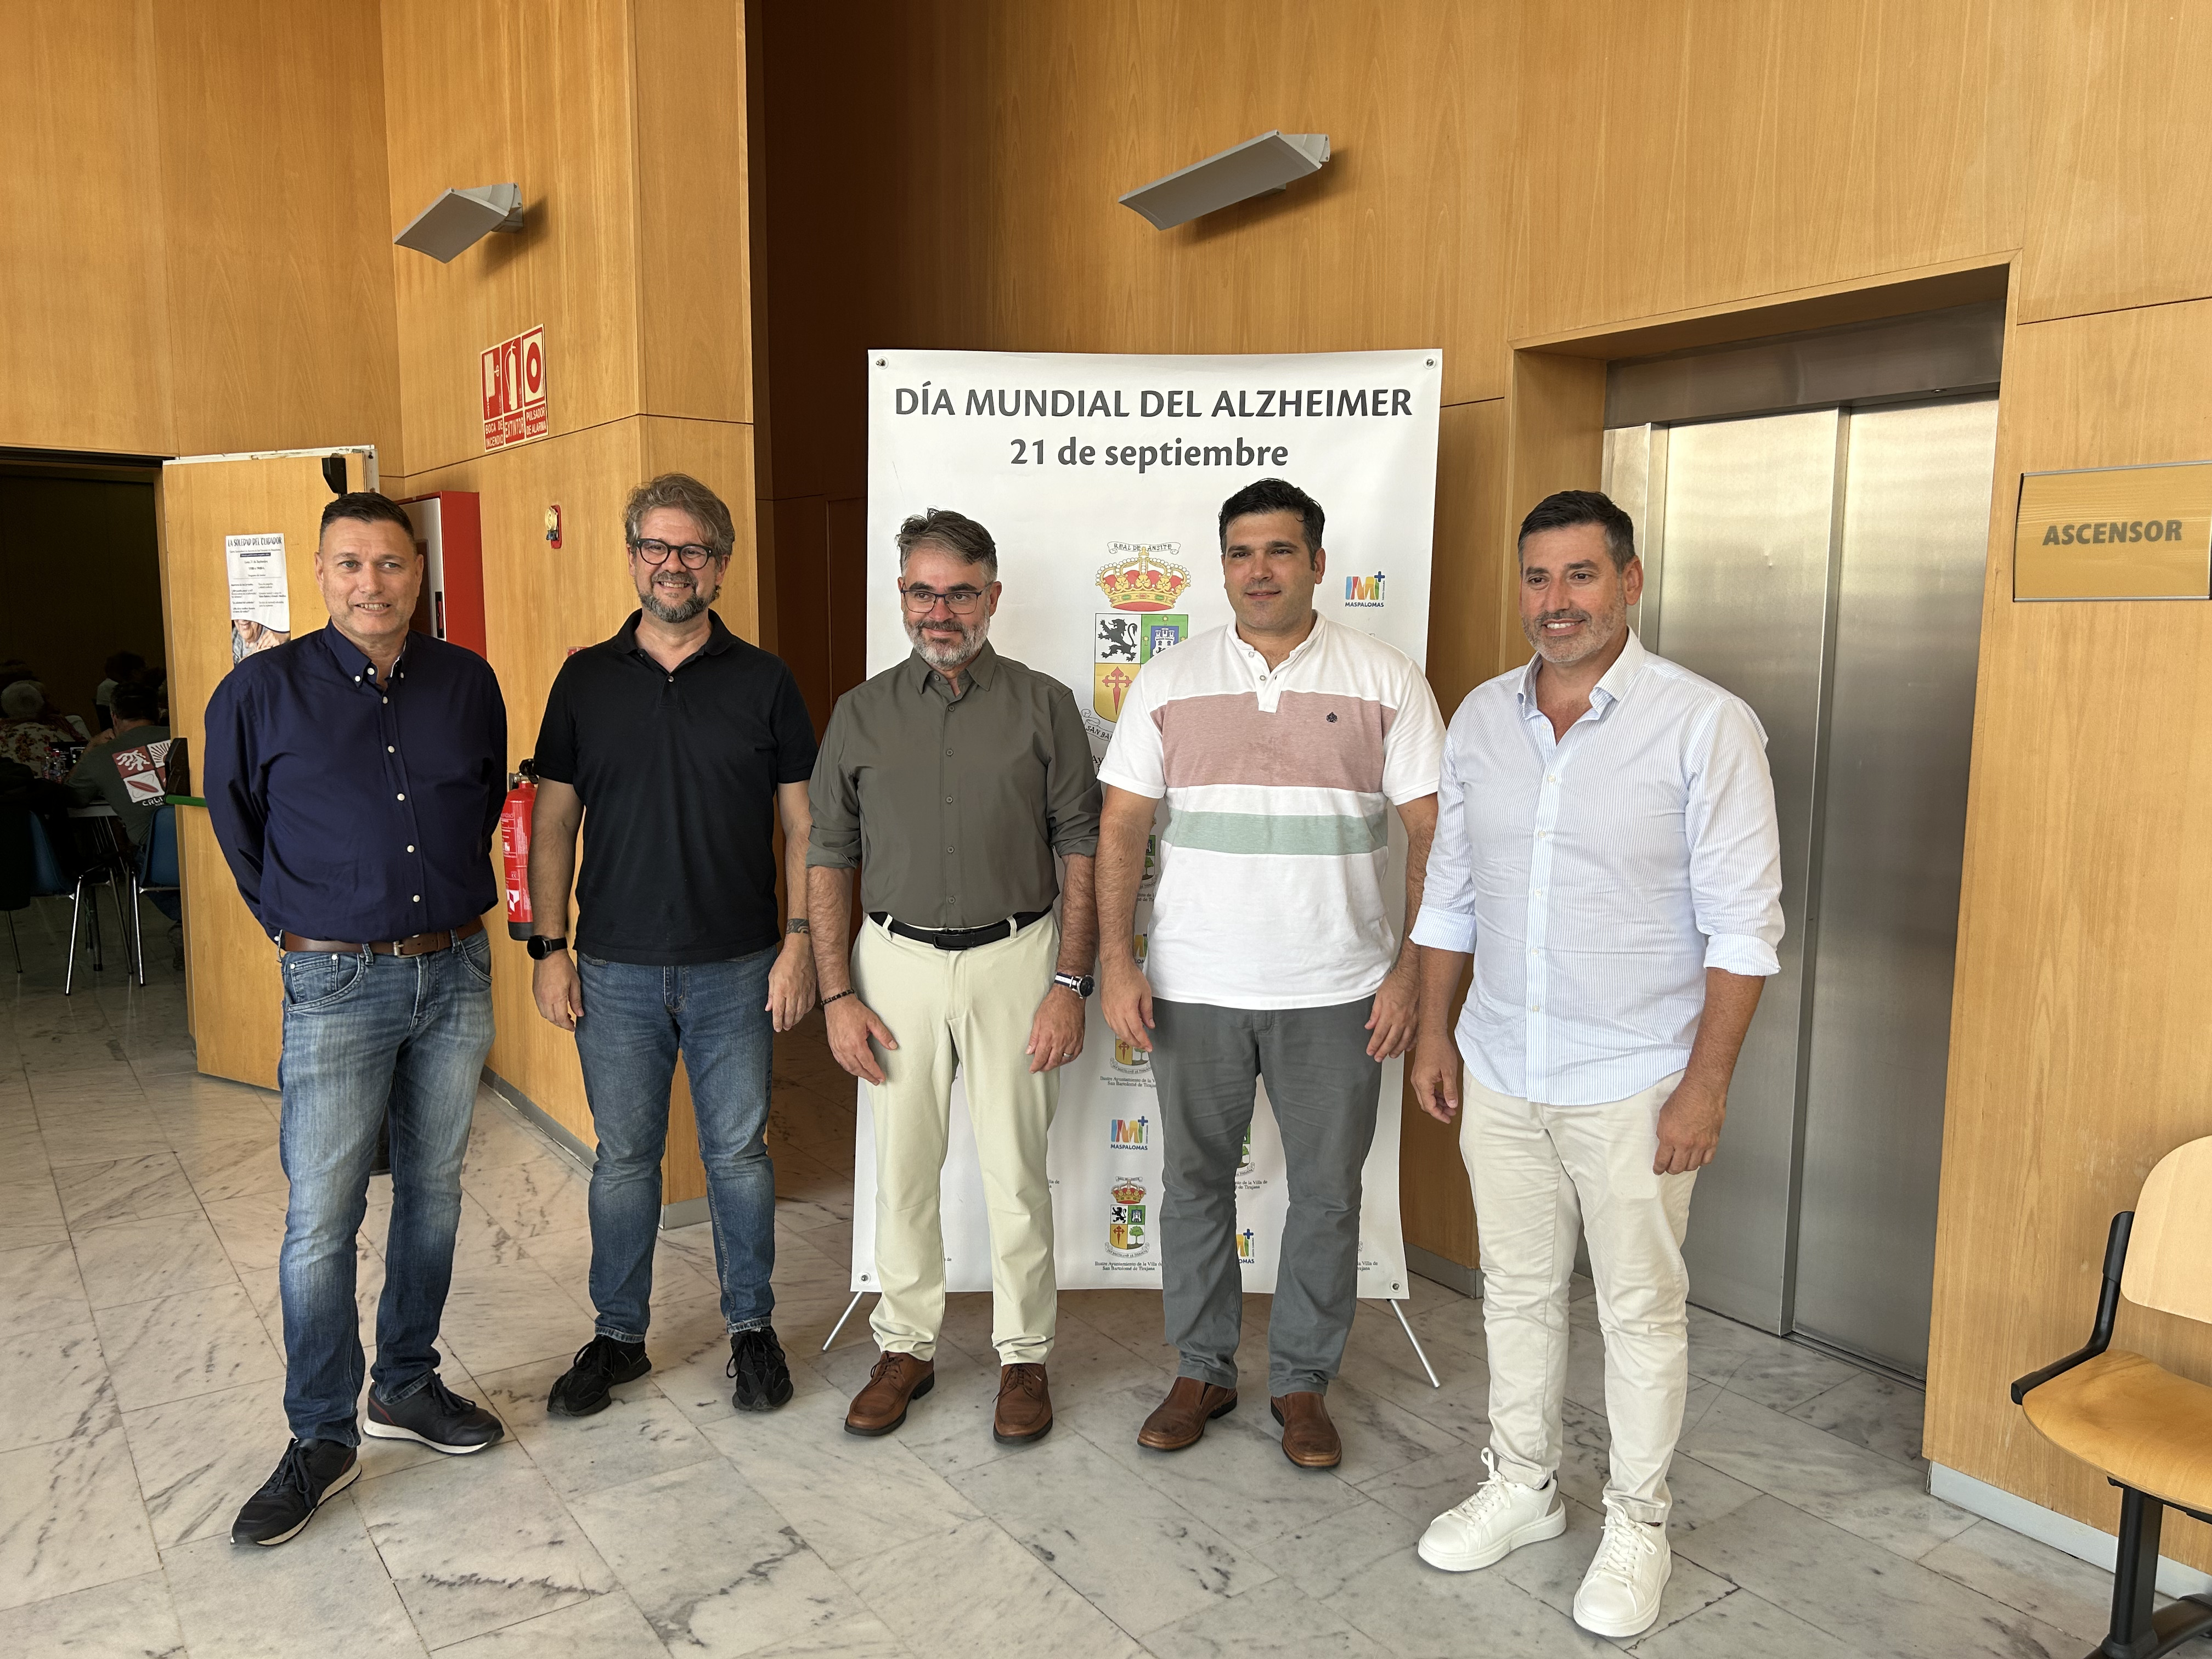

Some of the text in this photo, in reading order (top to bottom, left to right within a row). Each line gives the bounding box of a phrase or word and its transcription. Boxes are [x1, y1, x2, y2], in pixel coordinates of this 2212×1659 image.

[895, 380, 1413, 417] DÍA MUNDIAL DEL ALZHEIMER
[526, 407, 545, 422] PULSADOR
[485, 420, 503, 435] BOCA DE
[505, 417, 525, 438] EXTINTOR
[526, 420, 548, 436] DE ALARMA
[486, 434, 504, 448] INCENDIO
[1010, 437, 1289, 474] 21 de septiembre
[2041, 519, 2183, 546] ASCENSOR
[1086, 725, 1101, 735] SAN
